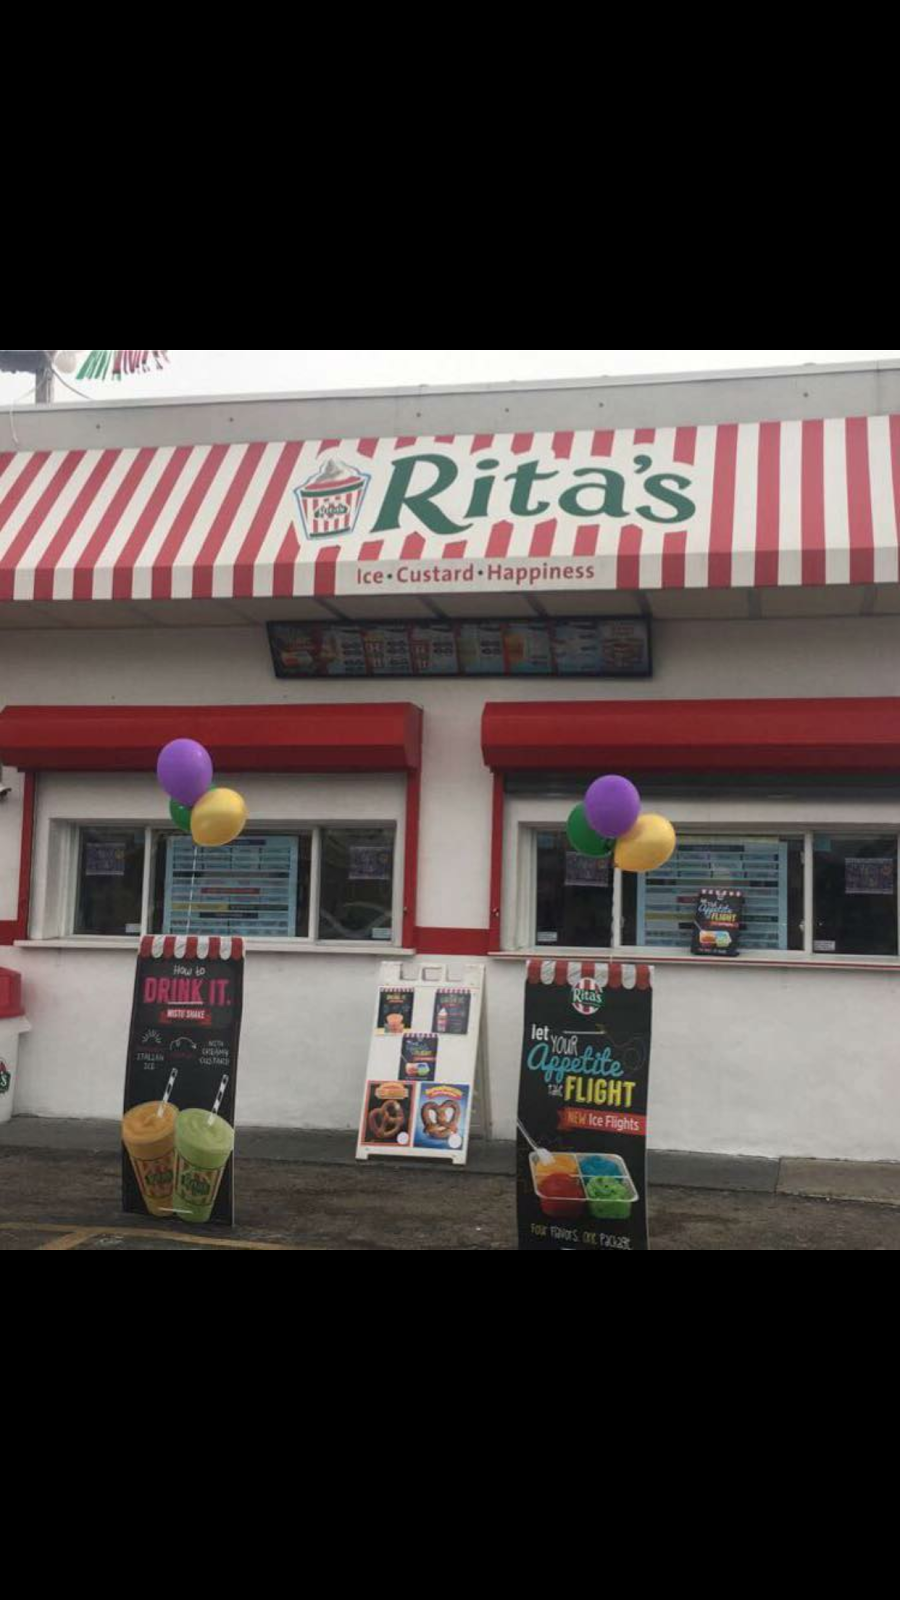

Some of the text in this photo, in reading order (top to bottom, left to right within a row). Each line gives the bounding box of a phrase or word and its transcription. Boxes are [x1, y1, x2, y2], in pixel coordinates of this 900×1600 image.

[370, 453, 697, 535] Rita's
[357, 562, 595, 585] Ice Custard Happiness
[195, 965, 206, 976] to
[143, 977, 231, 1006] DRINK IT.
[572, 987, 603, 1003] Rita's
[531, 1024, 578, 1056] let YOUR
[527, 1042, 624, 1083] Appetite
[563, 1075, 636, 1108] FLIGHT
[589, 1113, 604, 1126] Ice
[605, 1115, 640, 1131] Flights
